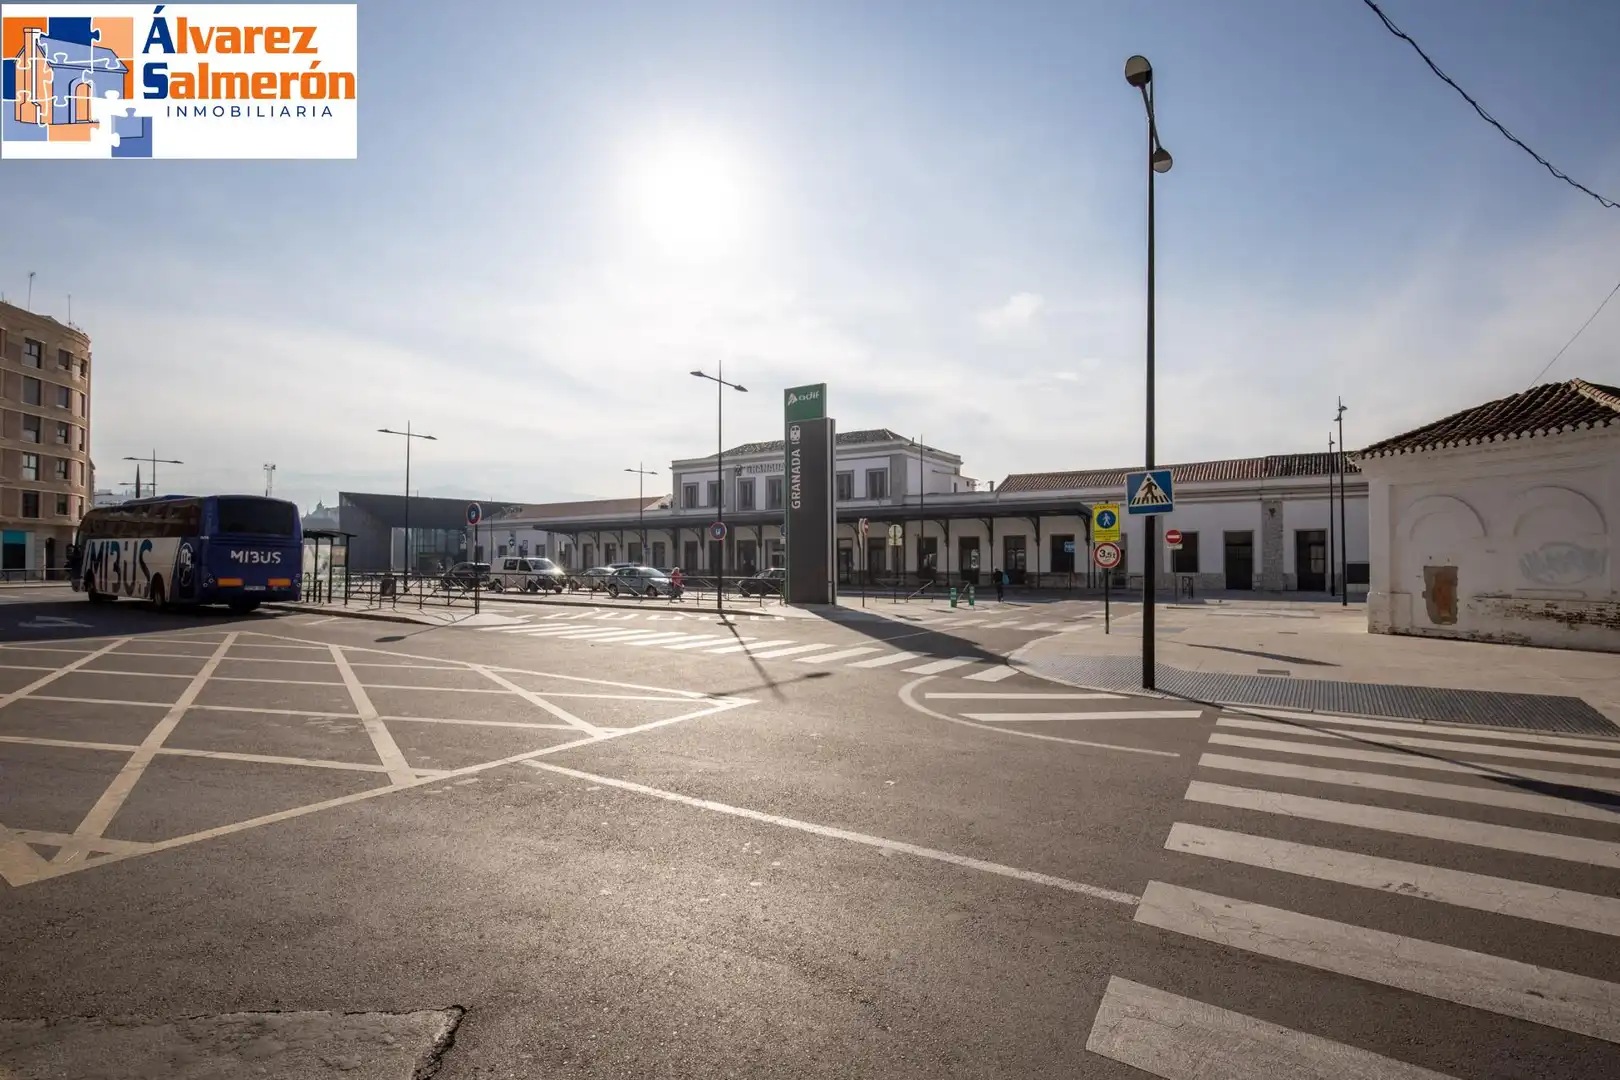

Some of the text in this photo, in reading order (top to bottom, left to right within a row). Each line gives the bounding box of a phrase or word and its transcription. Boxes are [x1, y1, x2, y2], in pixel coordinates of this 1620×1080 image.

[798, 390, 820, 401] adif
[791, 448, 801, 510] GRANADA
[230, 549, 282, 564] MIBUS
